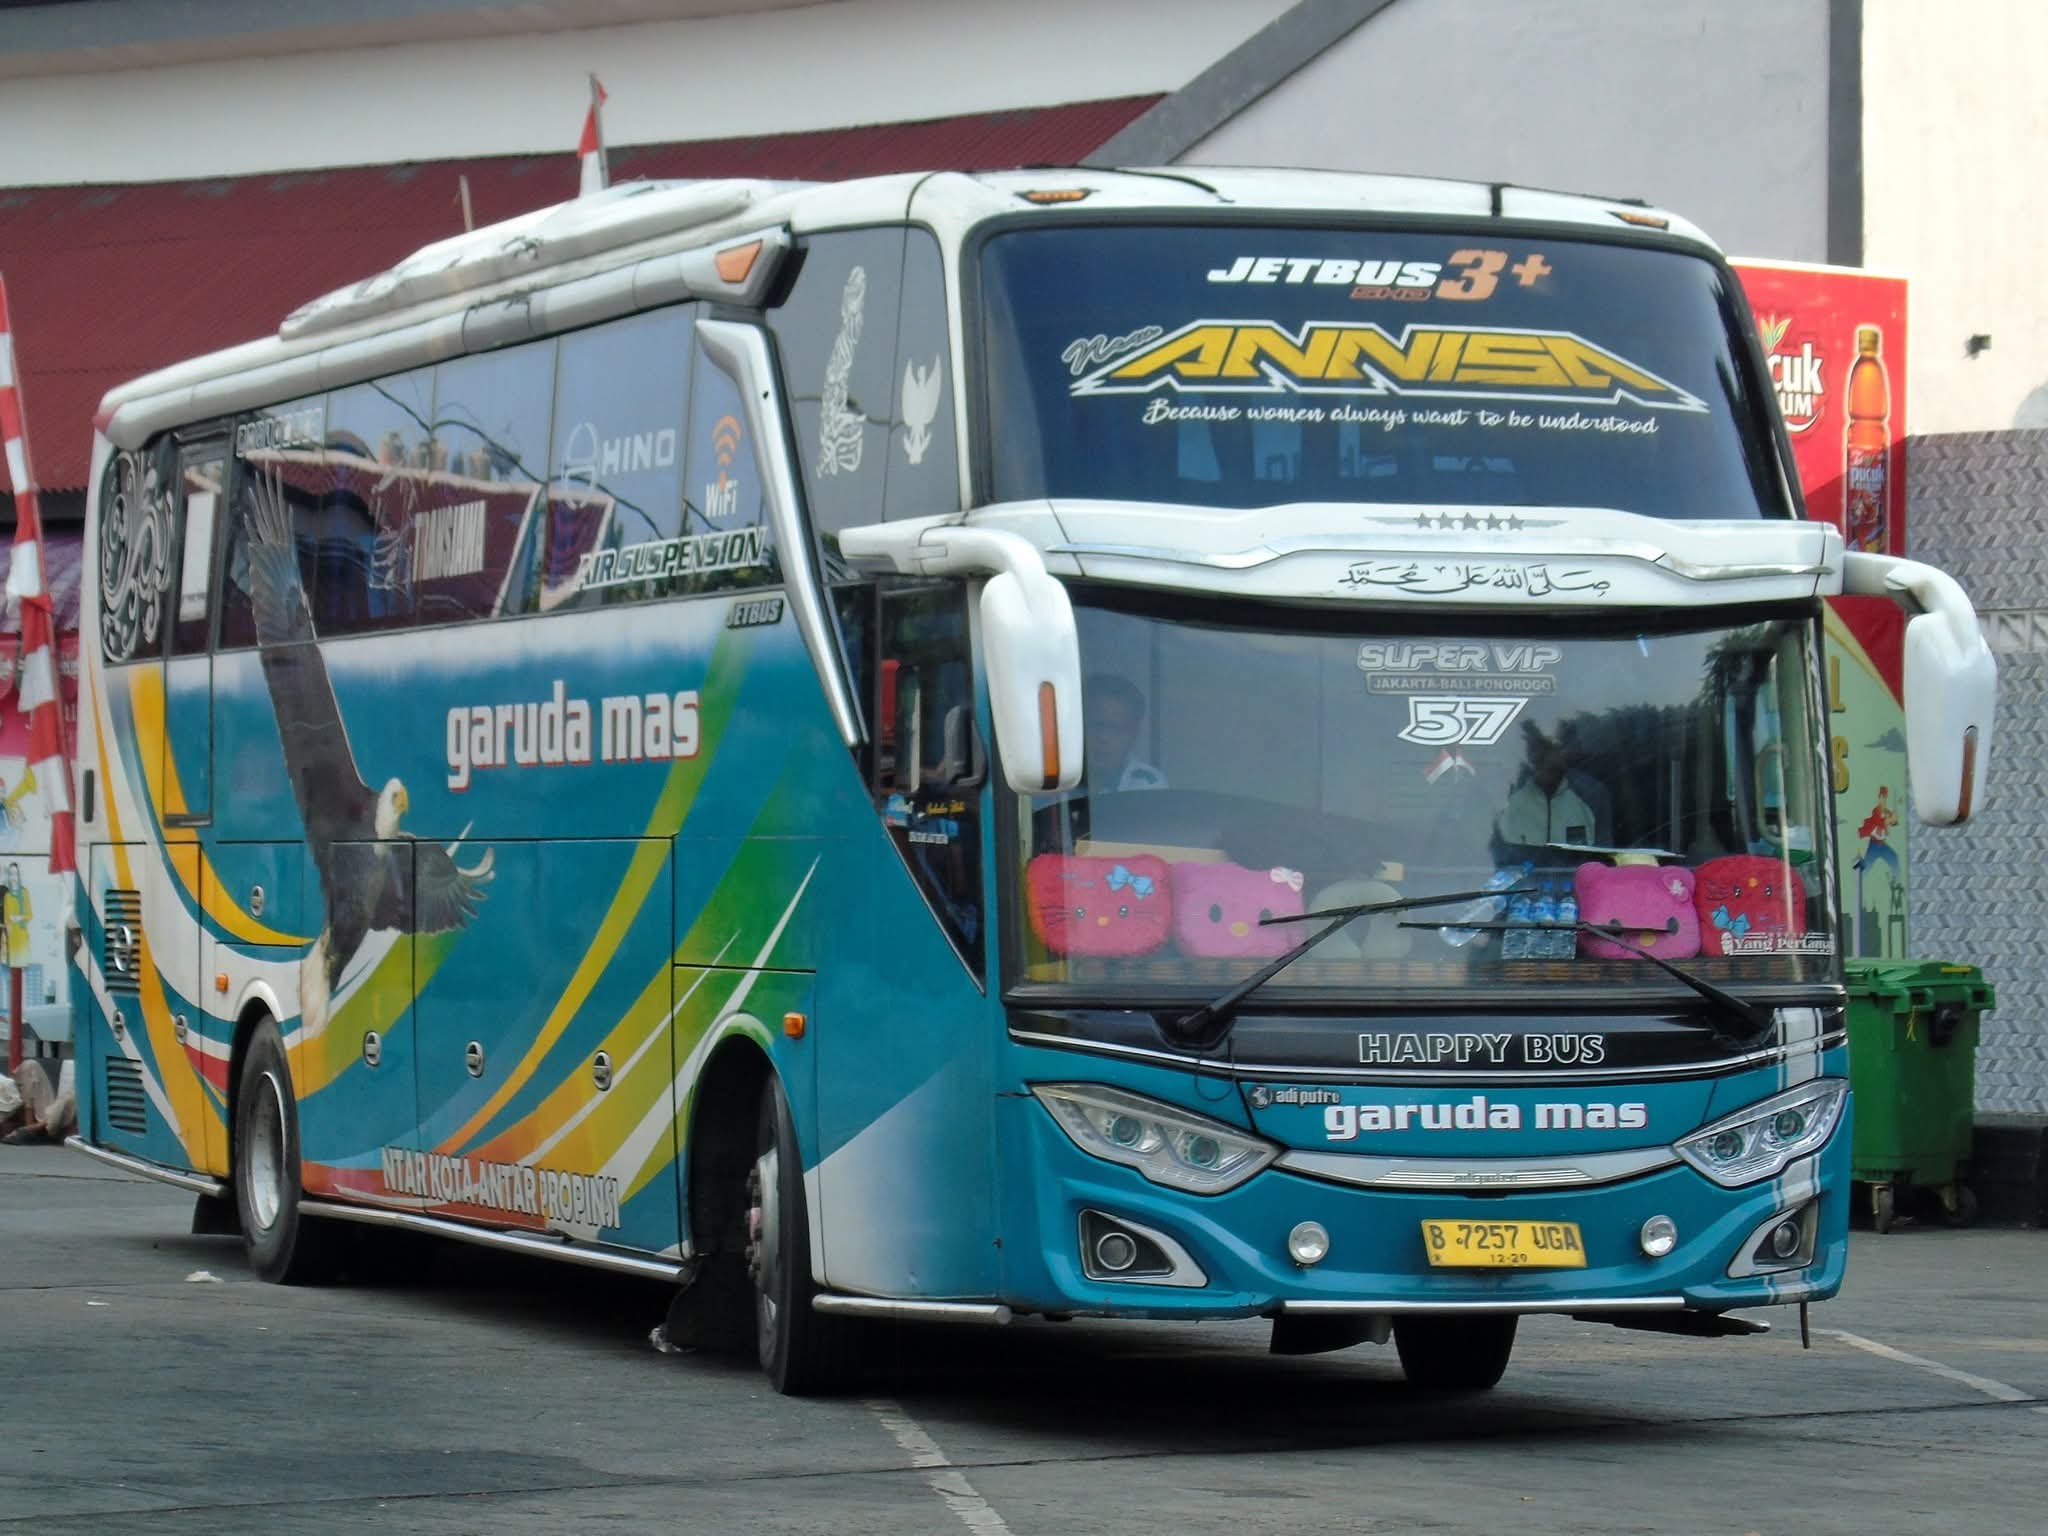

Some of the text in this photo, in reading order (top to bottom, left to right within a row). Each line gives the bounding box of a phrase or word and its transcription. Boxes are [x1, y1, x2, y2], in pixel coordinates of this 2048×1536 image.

[1207, 256, 1442, 288] JETBUS
[1098, 323, 1680, 396] ANNISA
[1142, 398, 1661, 435] Because women always want to be understood
[602, 429, 675, 475] HINO
[706, 479, 738, 518] WiFi
[1358, 642, 1563, 672] SUPER VIP
[446, 679, 699, 793] garuda mas
[1397, 696, 1529, 746] 57
[1358, 1033, 1606, 1064] HAPPY BUS
[1323, 1095, 1648, 1141] garuda mas
[1429, 1224, 1580, 1252] B 7257 UGA
